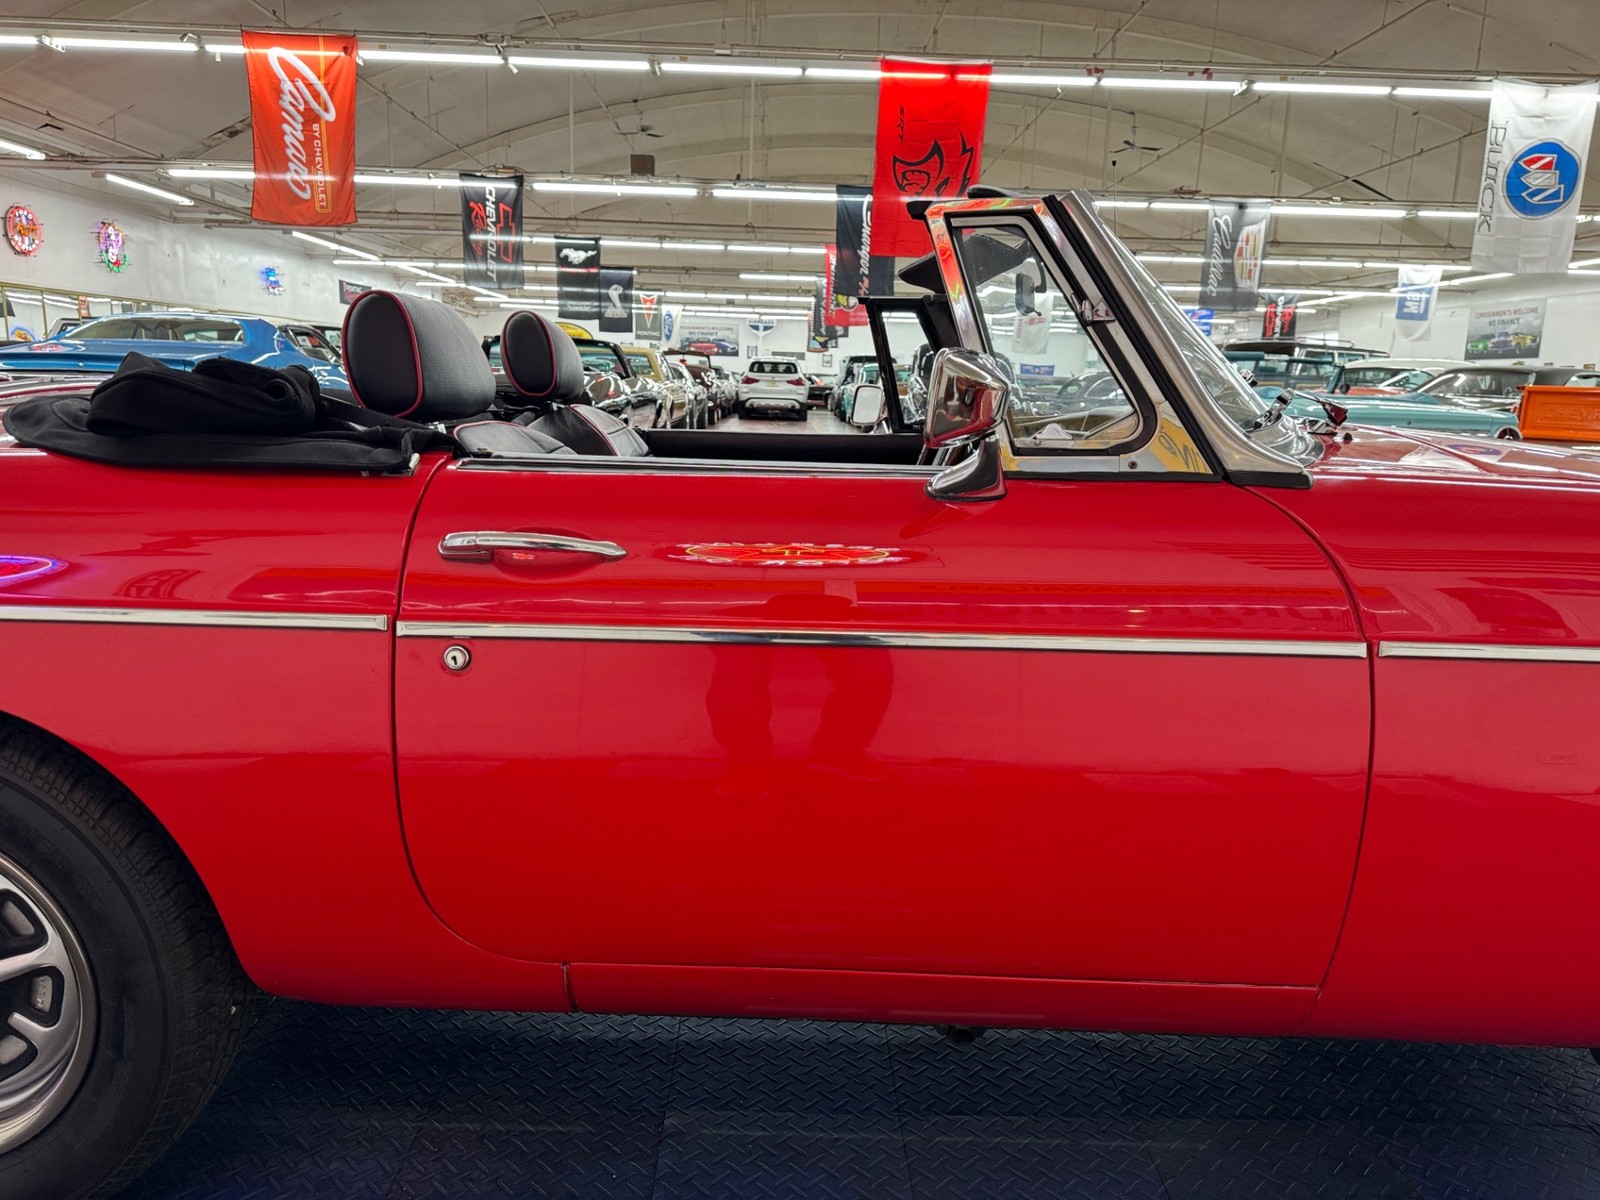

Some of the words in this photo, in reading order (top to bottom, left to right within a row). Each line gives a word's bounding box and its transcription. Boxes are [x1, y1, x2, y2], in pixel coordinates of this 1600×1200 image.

[267, 47, 337, 200] Camaro
[312, 123, 320, 139] BY
[313, 140, 327, 208] CHEVROLET
[485, 185, 497, 282] CHEVROLET
[1207, 214, 1233, 297] Cadillac
[1497, 317, 1521, 327] FINANCE
[1513, 306, 1539, 317] WELCOME
